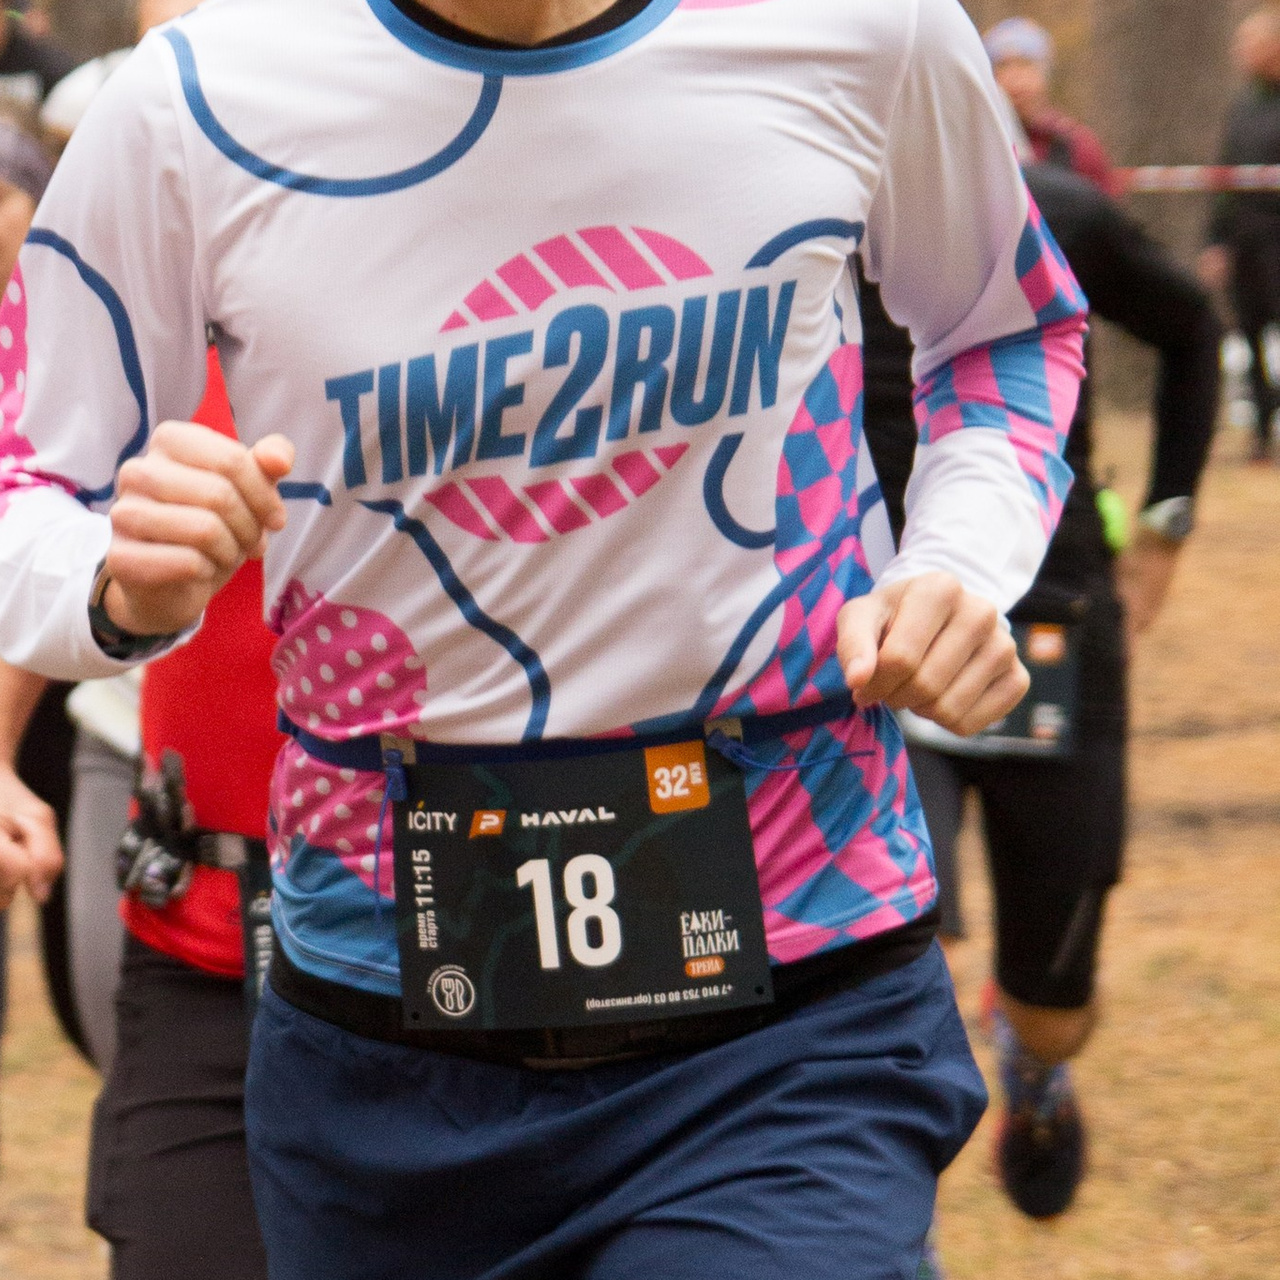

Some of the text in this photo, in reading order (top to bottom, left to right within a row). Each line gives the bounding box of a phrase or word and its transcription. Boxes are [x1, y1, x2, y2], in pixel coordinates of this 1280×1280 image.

[324, 279, 798, 490] TIME2RUN
[654, 764, 690, 799] 32
[521, 806, 616, 827] HAVAL
[412, 848, 435, 907] 11:15
[516, 853, 623, 969] 18
[682, 928, 740, 958] ПАЛКИ
